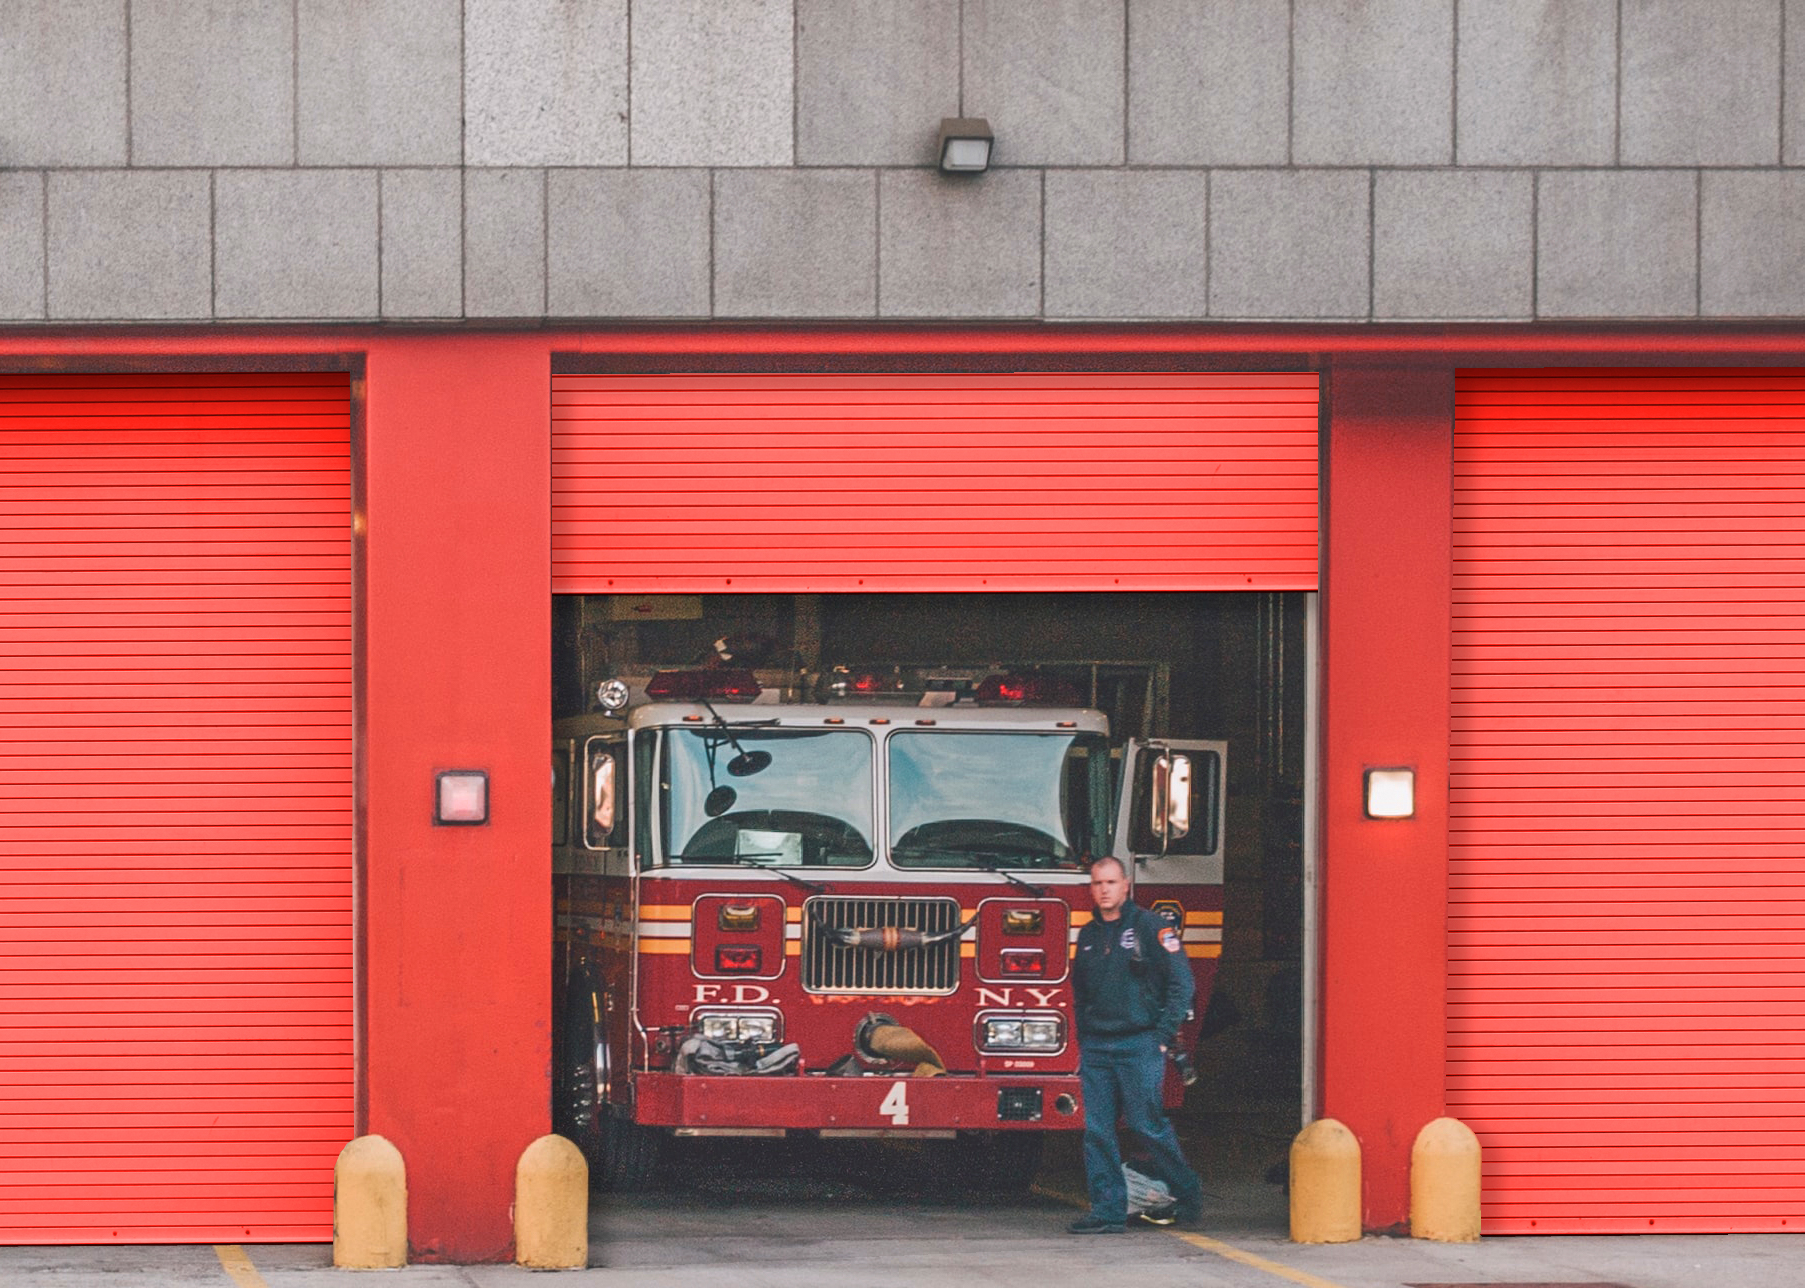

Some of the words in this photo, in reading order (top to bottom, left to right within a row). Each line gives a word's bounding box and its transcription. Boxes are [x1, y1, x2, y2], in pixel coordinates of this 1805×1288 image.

[692, 984, 781, 1004] F.D.
[973, 987, 1067, 1007] N.Y.
[879, 1081, 909, 1125] 4
